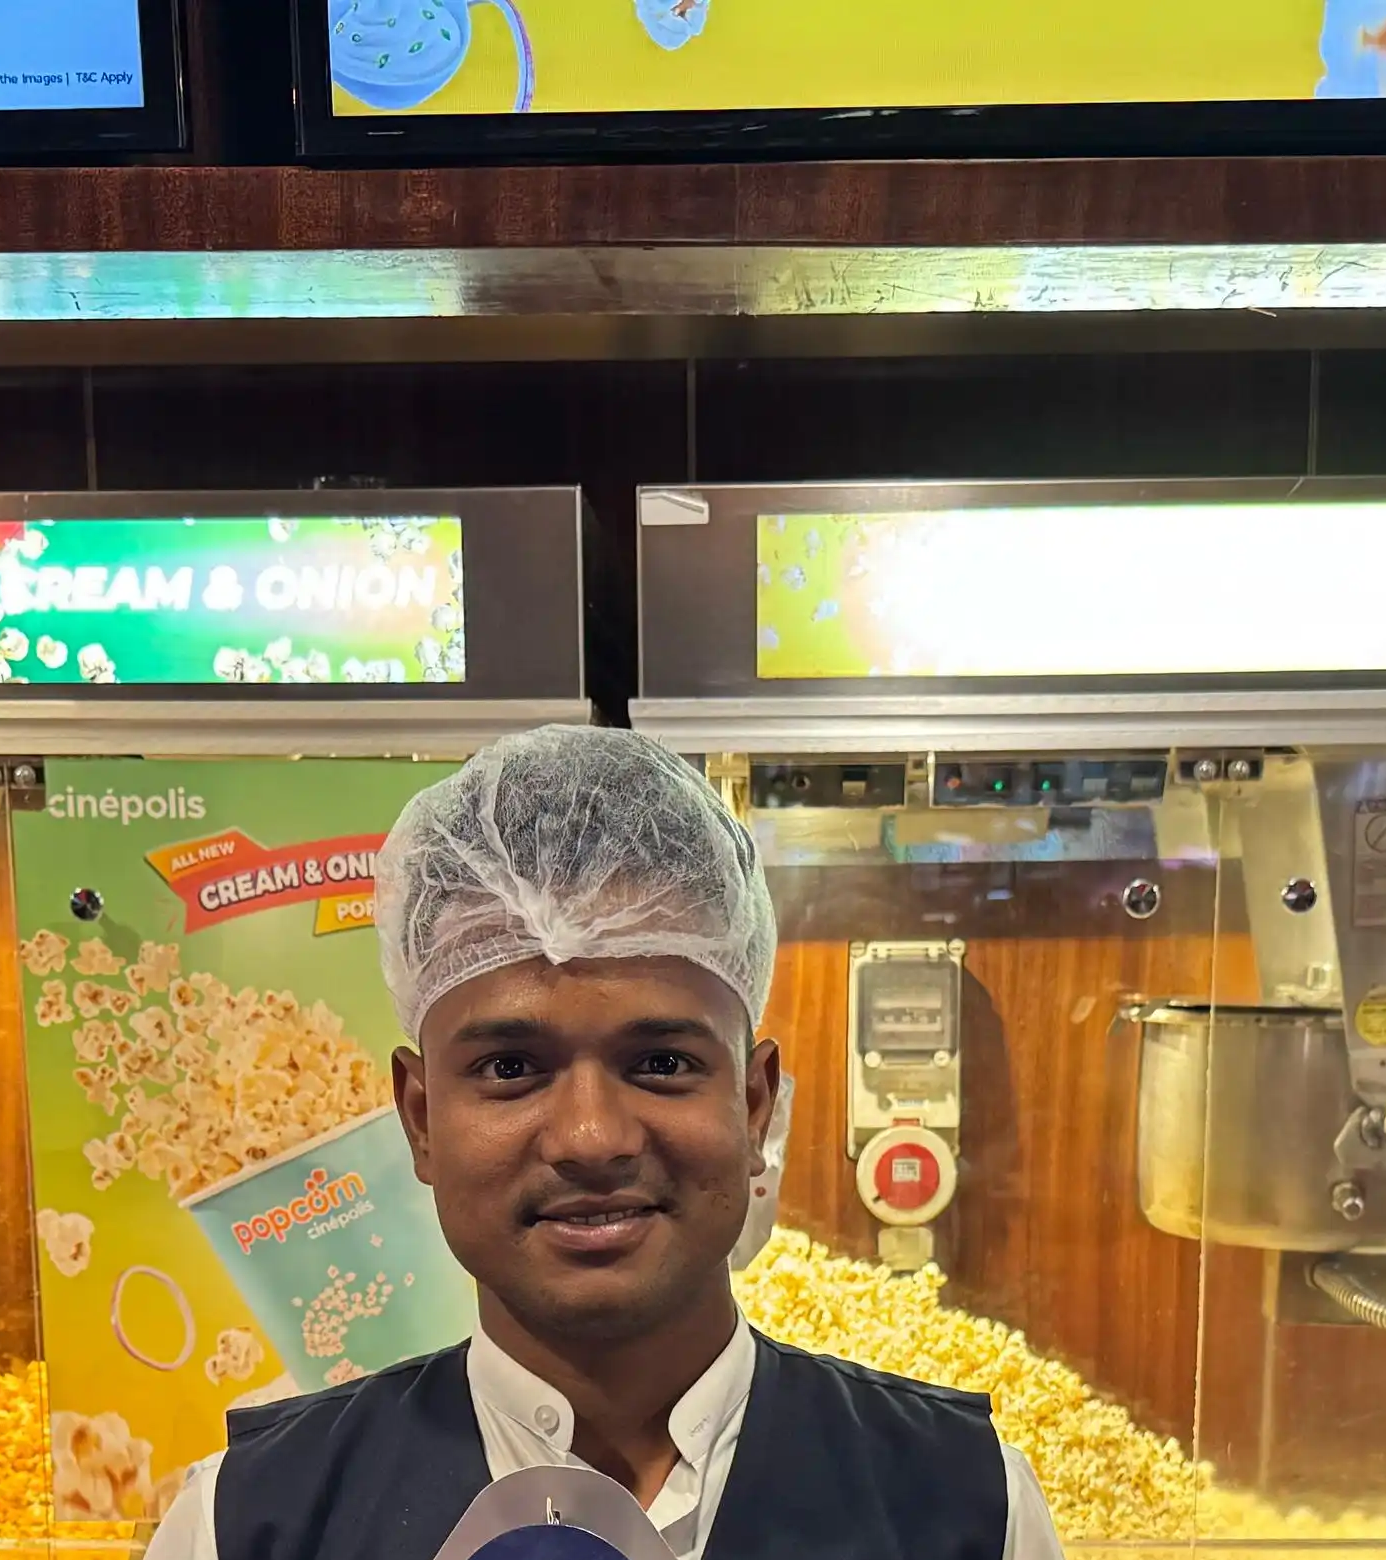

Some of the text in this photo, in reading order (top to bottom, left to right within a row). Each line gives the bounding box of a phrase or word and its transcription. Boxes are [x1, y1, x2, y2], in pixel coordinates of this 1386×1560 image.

[75, 72, 98, 84] T&C
[101, 70, 134, 85] Apply
[203, 564, 245, 611] &
[256, 563, 437, 611] ONION
[48, 786, 207, 826] cinépolis
[171, 841, 235, 872] ALL NEW
[198, 862, 300, 911] CREAM
[303, 858, 324, 885] &
[231, 1169, 367, 1255] popcorn
